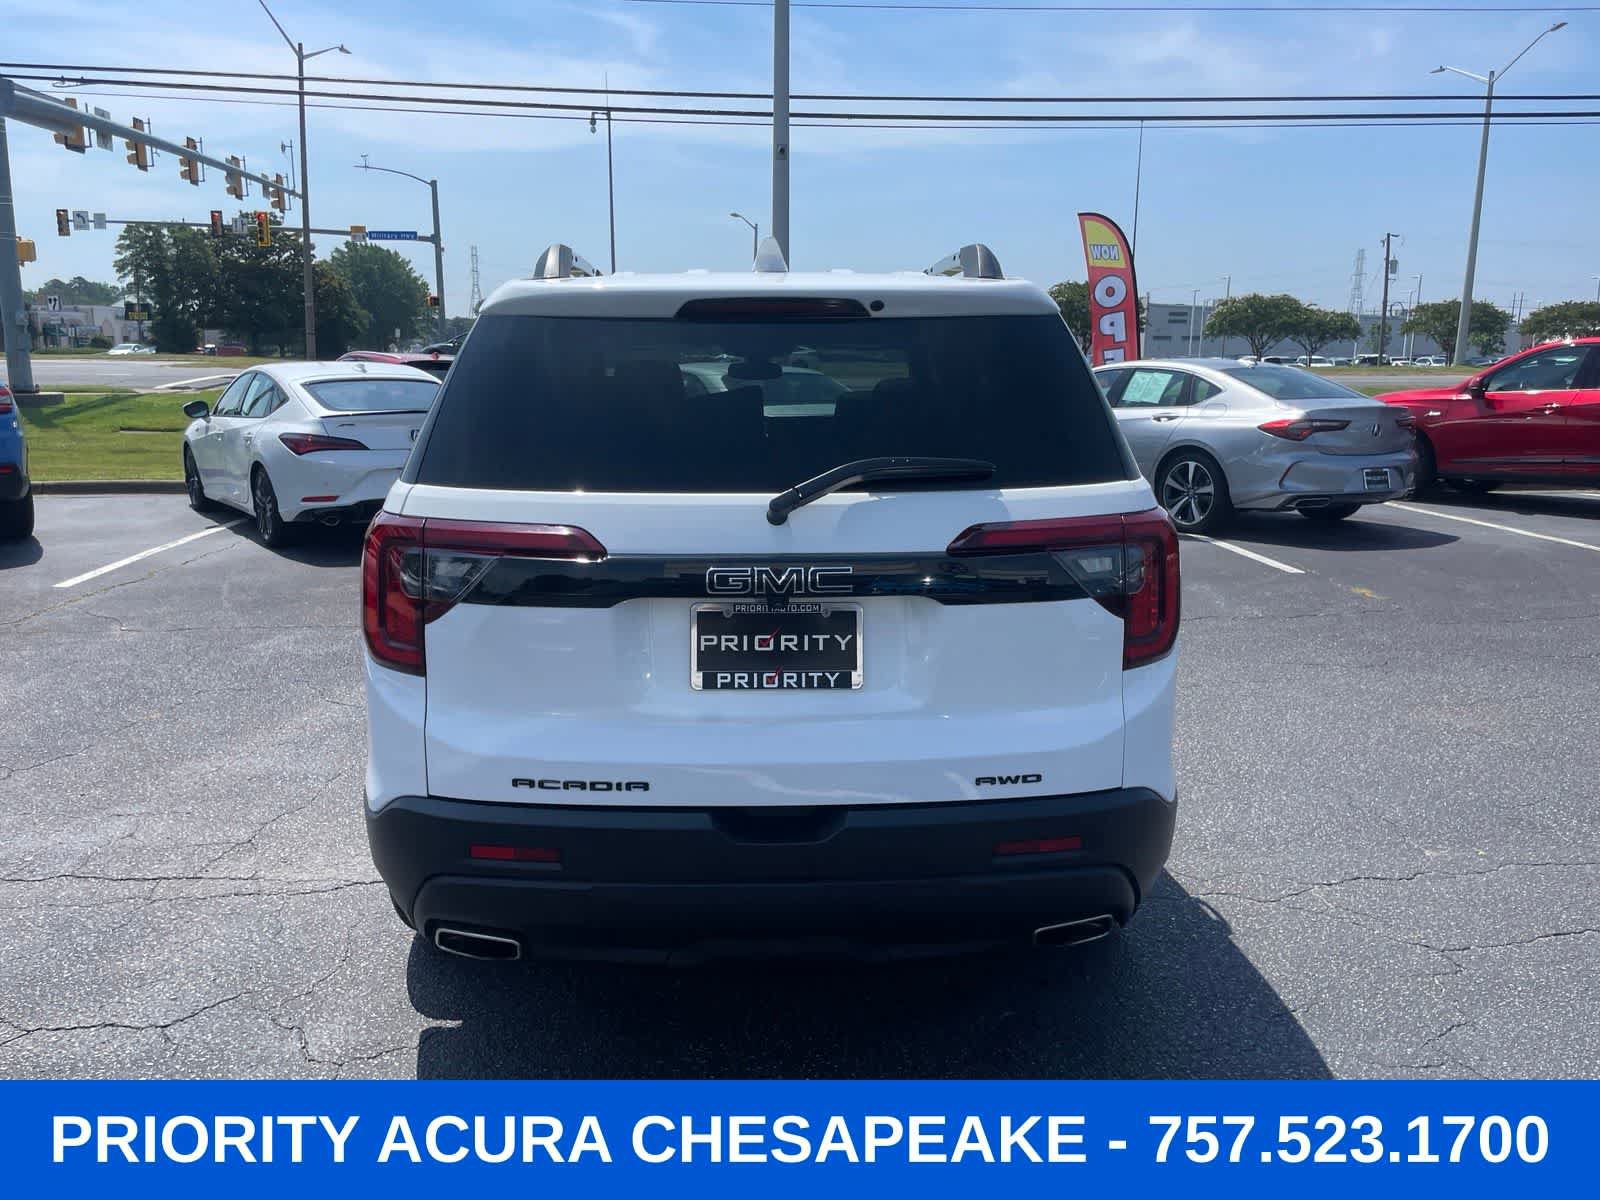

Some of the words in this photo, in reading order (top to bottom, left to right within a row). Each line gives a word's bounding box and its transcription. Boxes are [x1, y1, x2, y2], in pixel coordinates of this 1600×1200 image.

[706, 567, 853, 594] GMC
[700, 634, 852, 651] PRIORITY
[717, 672, 840, 688] PRIORITY
[511, 778, 650, 792] ACADIA
[975, 774, 1042, 786] AWD
